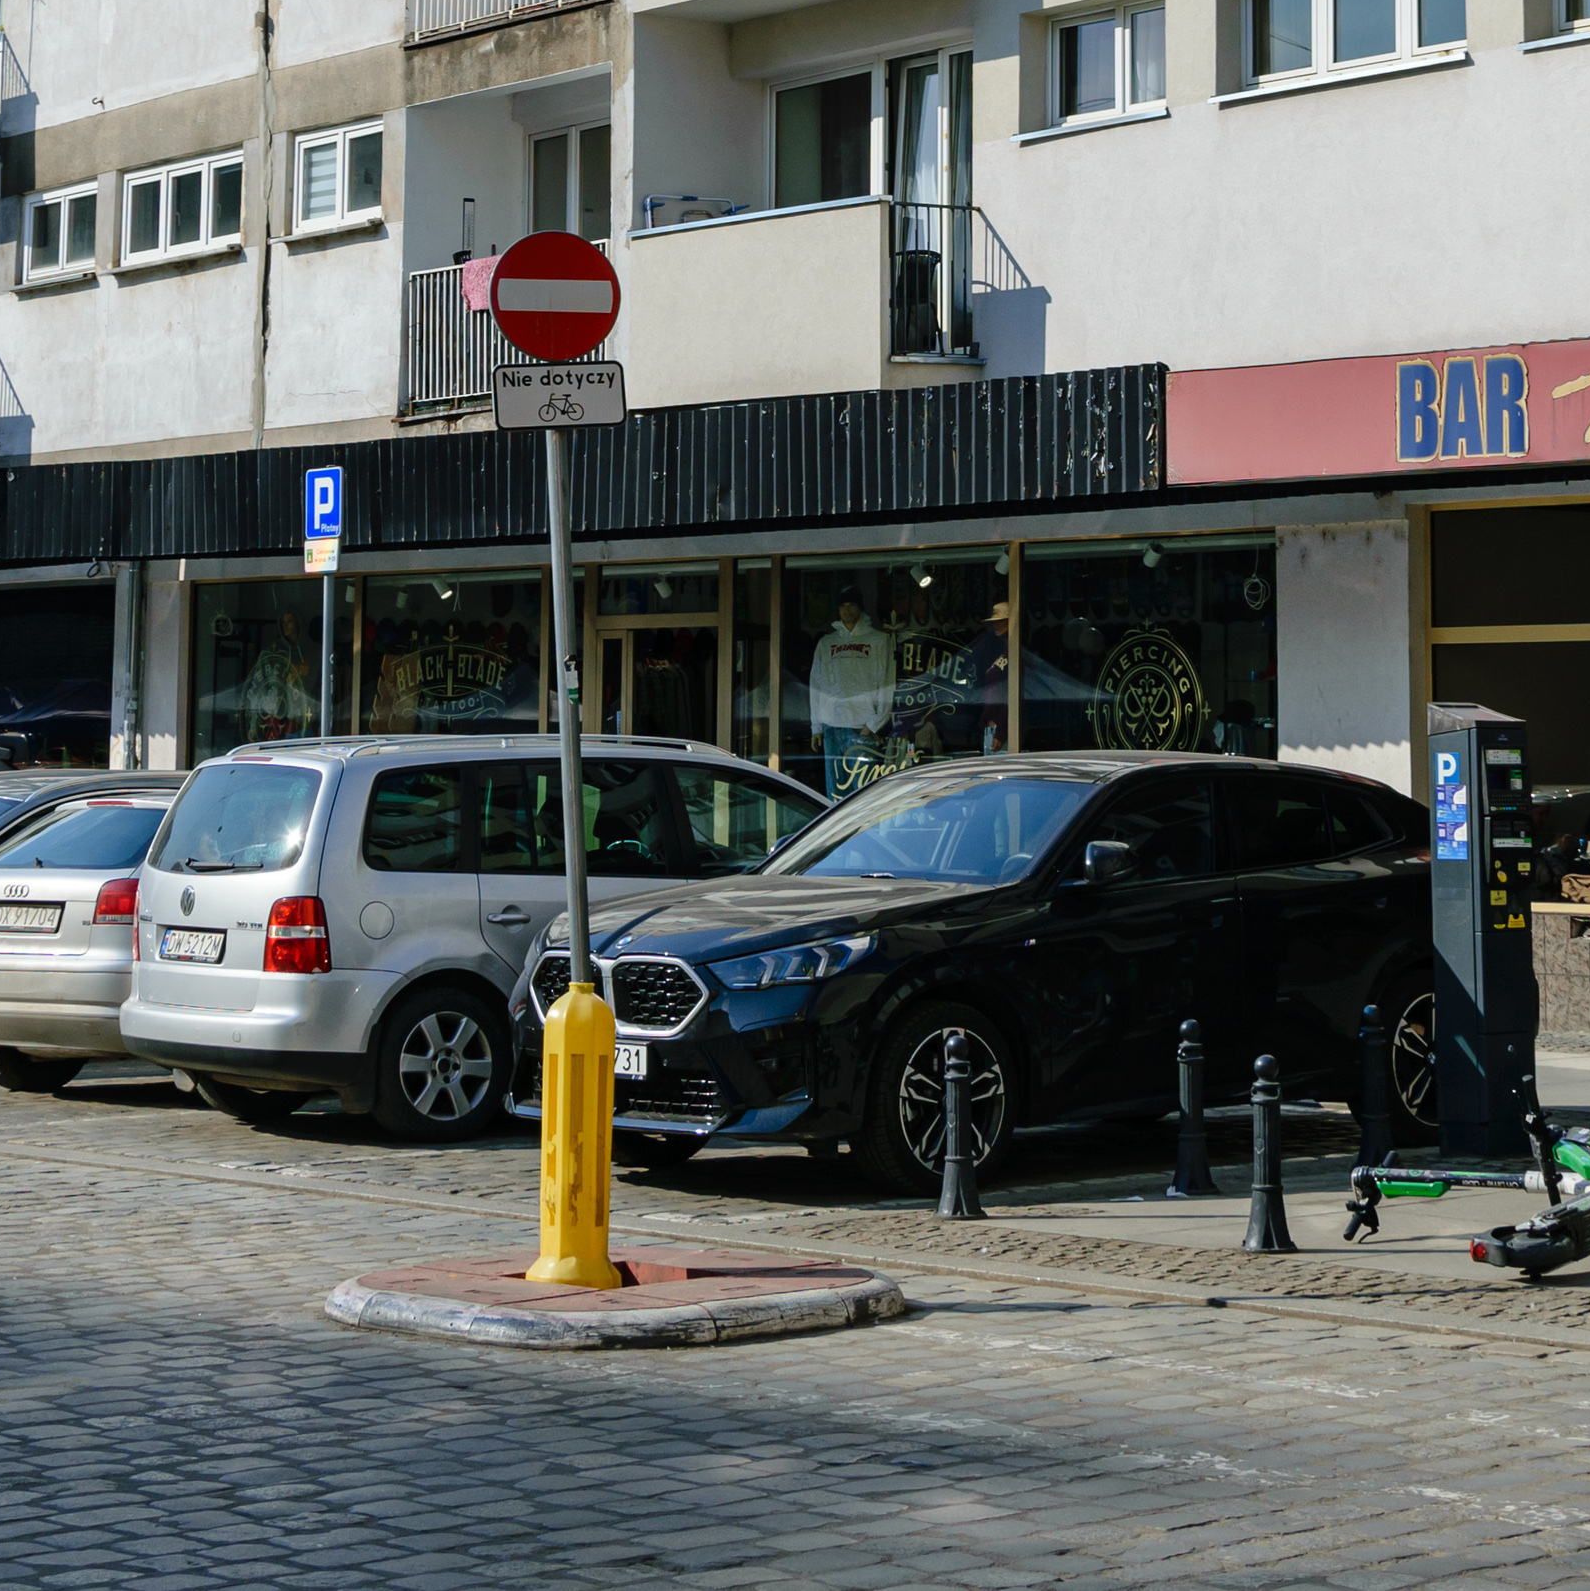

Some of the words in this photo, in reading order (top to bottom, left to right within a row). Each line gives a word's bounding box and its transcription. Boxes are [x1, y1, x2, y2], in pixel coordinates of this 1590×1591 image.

[502, 371, 533, 388] Nie
[540, 368, 616, 390] dotyczy
[1395, 352, 1530, 463] BAR
[314, 476, 334, 530] P
[395, 656, 445, 692] BLACK
[457, 653, 508, 692] BLADE
[903, 642, 967, 684] BLADE
[1104, 645, 1191, 694] PIERCING
[1437, 752, 1456, 784] P
[13, 906, 57, 927] 91704
[166, 932, 184, 953] DW
[184, 933, 226, 956] 5212M
